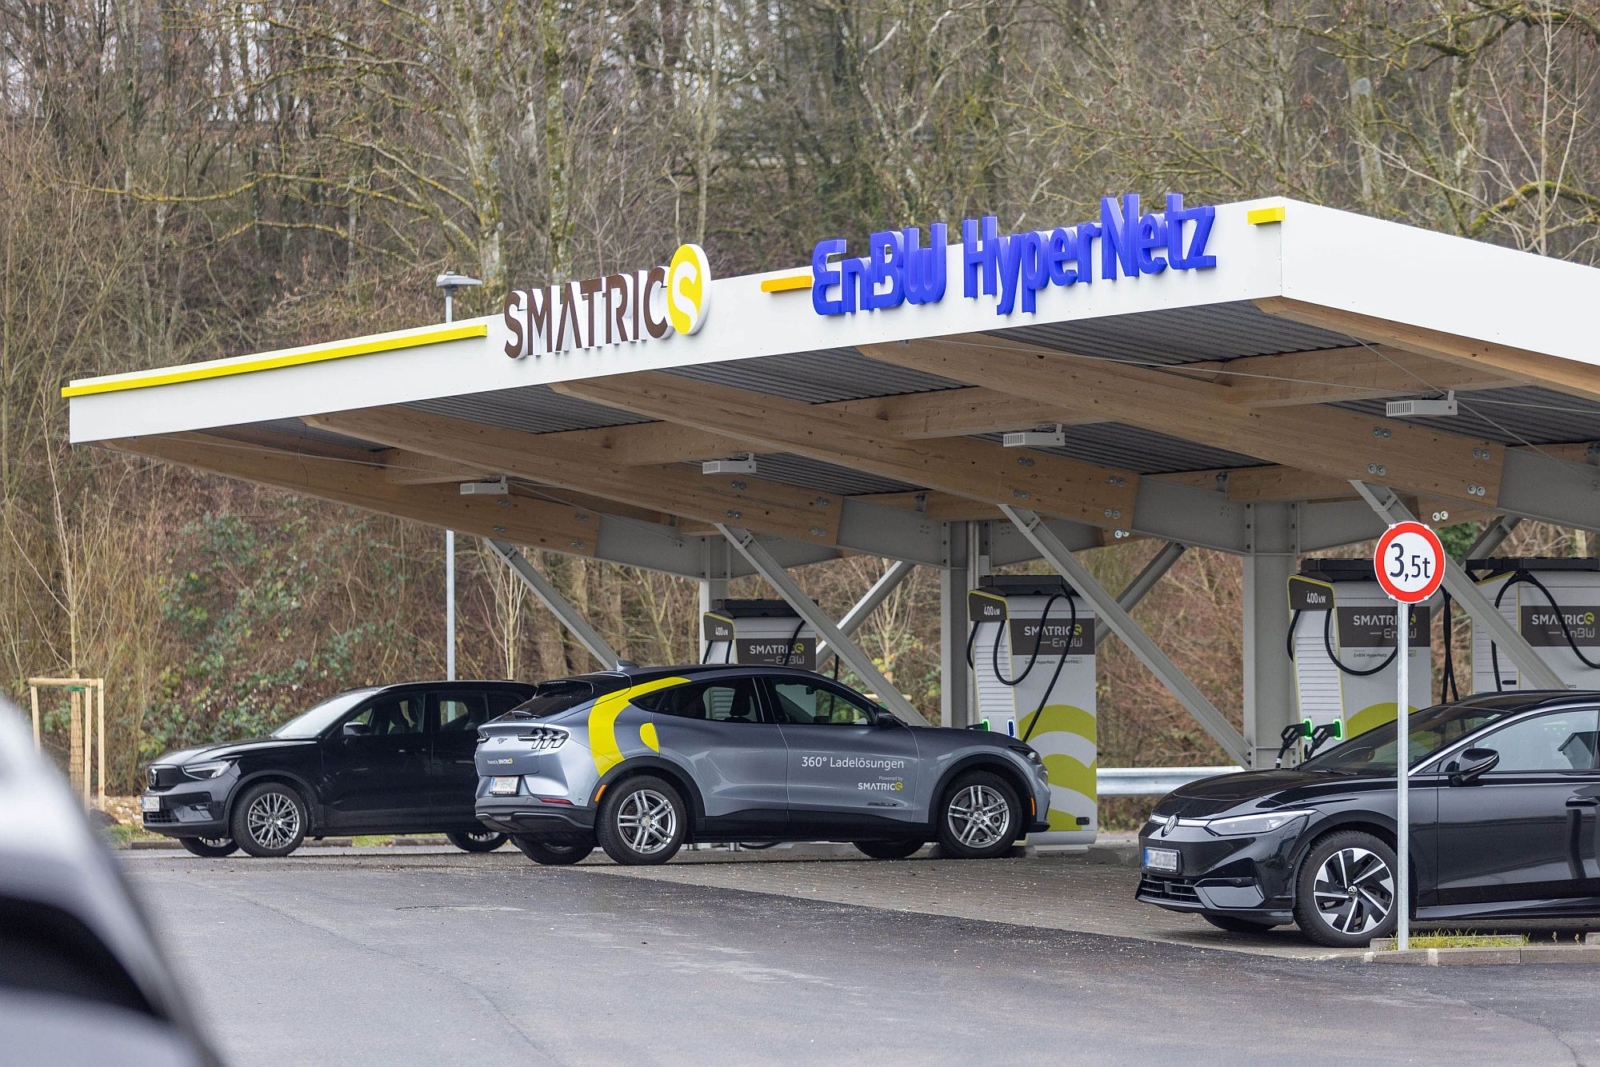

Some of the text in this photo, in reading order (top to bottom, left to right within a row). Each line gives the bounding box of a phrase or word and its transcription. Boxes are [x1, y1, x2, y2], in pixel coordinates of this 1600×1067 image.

[812, 193, 1217, 315] EnBW HyperNetz
[503, 243, 711, 360] SMATRICS
[1390, 543, 1431, 582] 3,5t
[801, 756, 905, 771] 360° Ladelösungen
